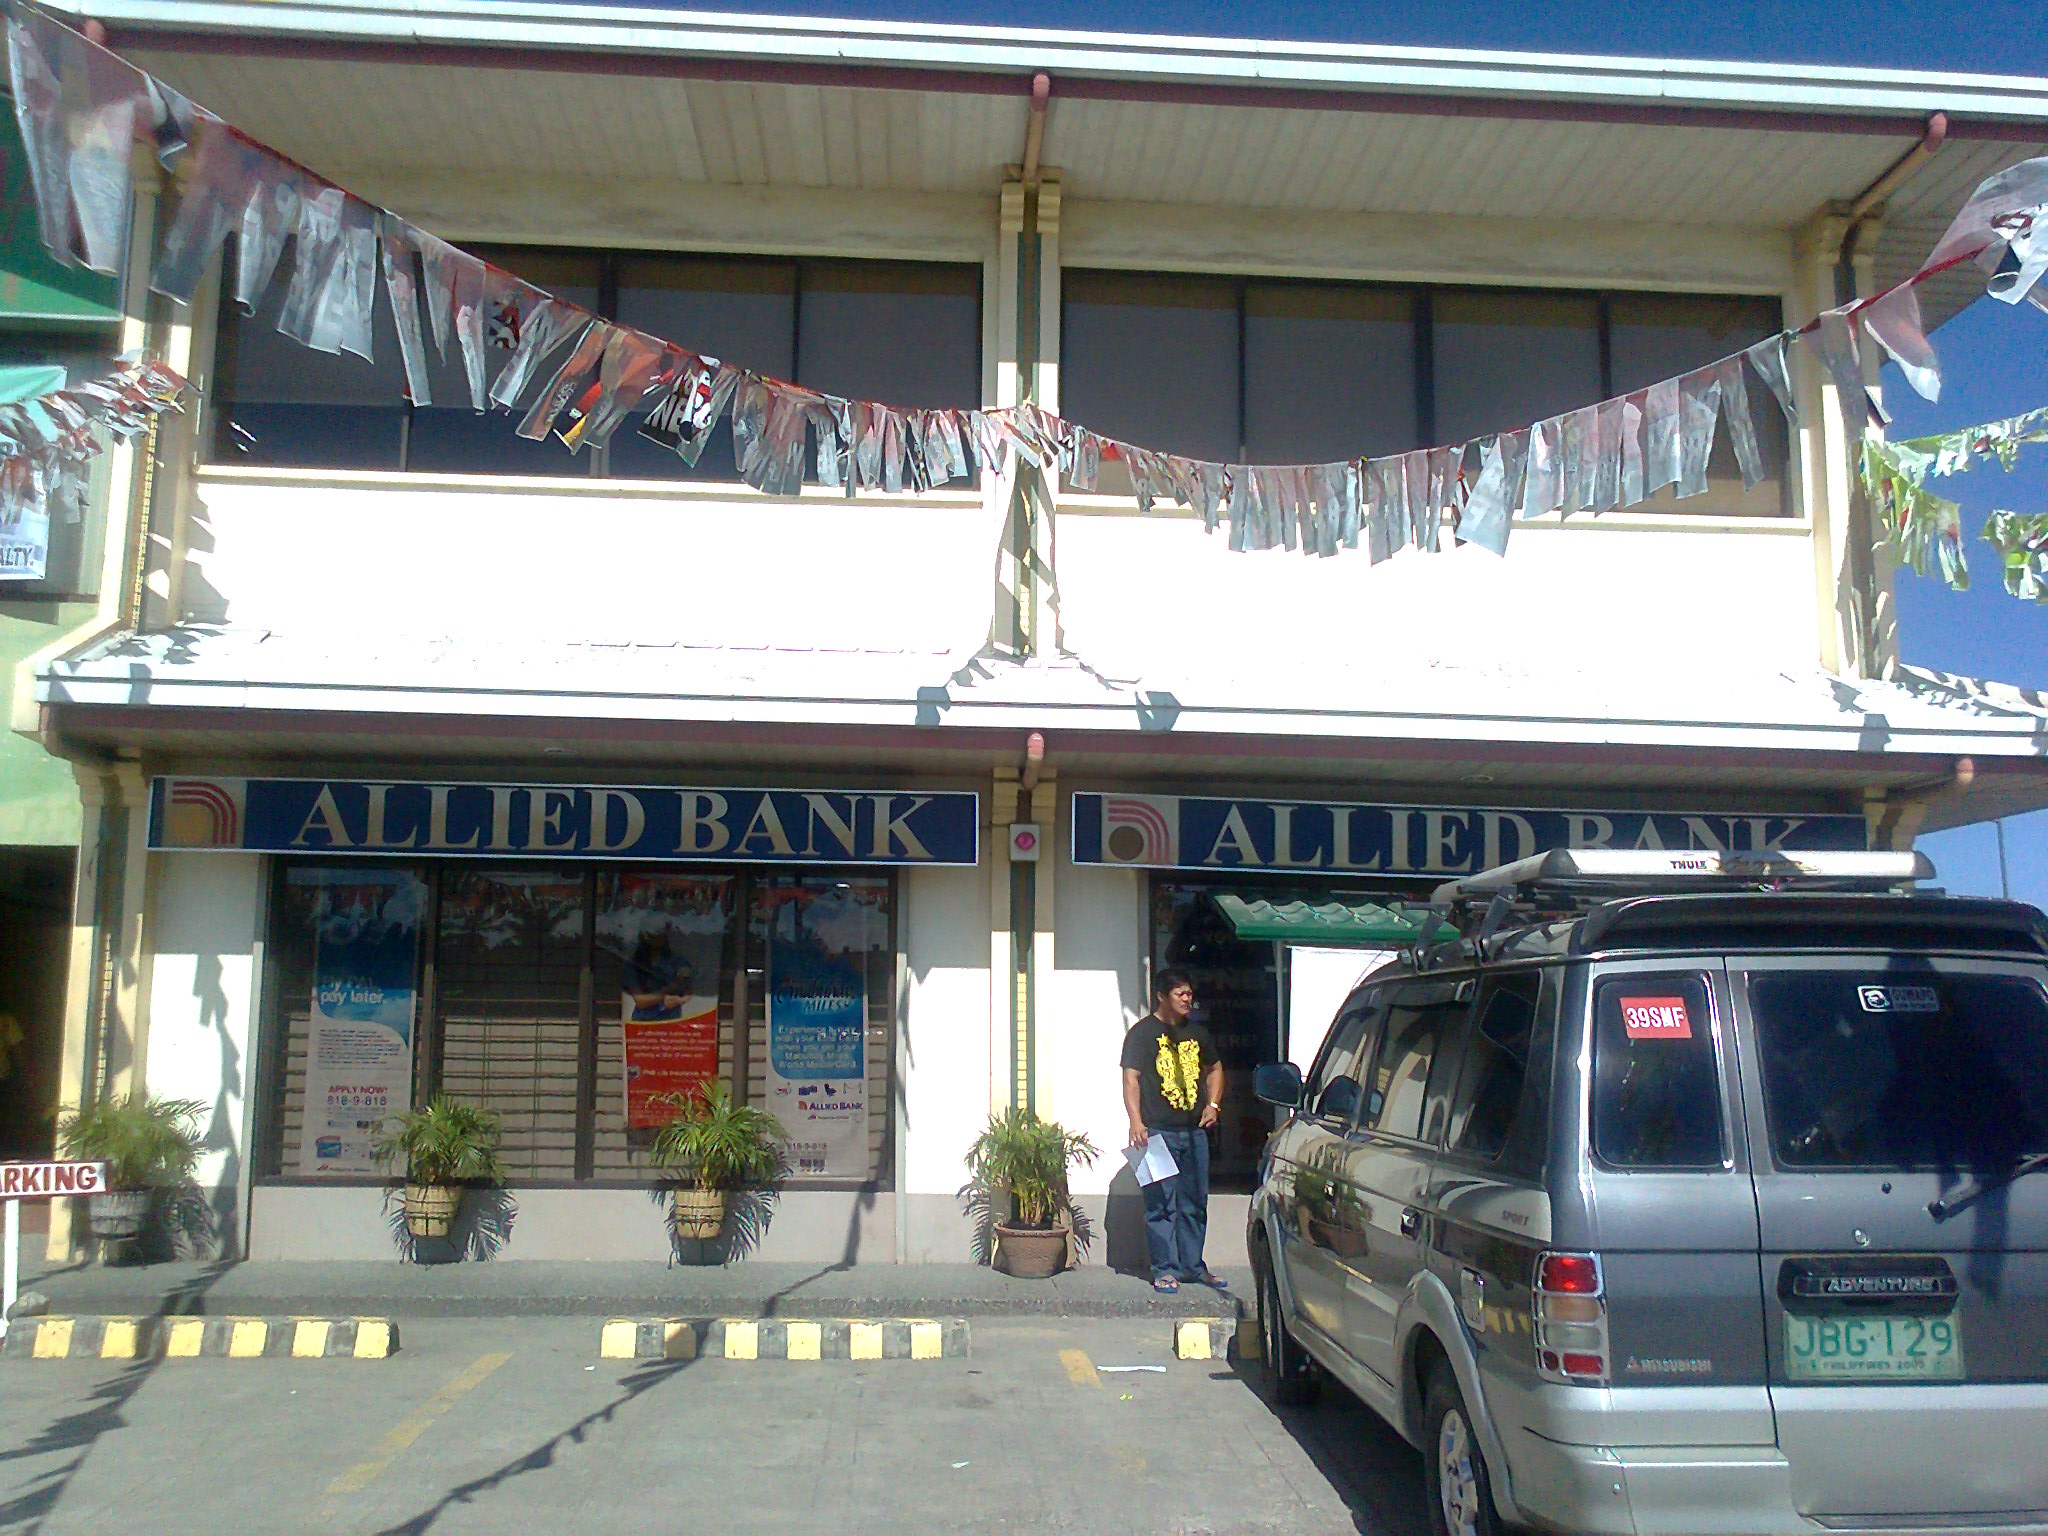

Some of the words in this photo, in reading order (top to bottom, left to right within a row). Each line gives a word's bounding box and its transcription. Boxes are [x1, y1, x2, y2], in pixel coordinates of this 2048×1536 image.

[290, 783, 645, 851] ALLIED
[673, 791, 935, 859] BANK
[1202, 803, 1536, 872] ALLIED
[1563, 814, 1806, 850] BANK
[1669, 860, 1707, 870] THULE
[320, 990, 347, 1006] pay
[328, 1085, 358, 1094] APPLY
[0, 1166, 98, 1194] RKING
[1827, 1278, 1933, 1292] ADVENTURE
[1639, 1358, 1712, 1373] MITSUBISHI
